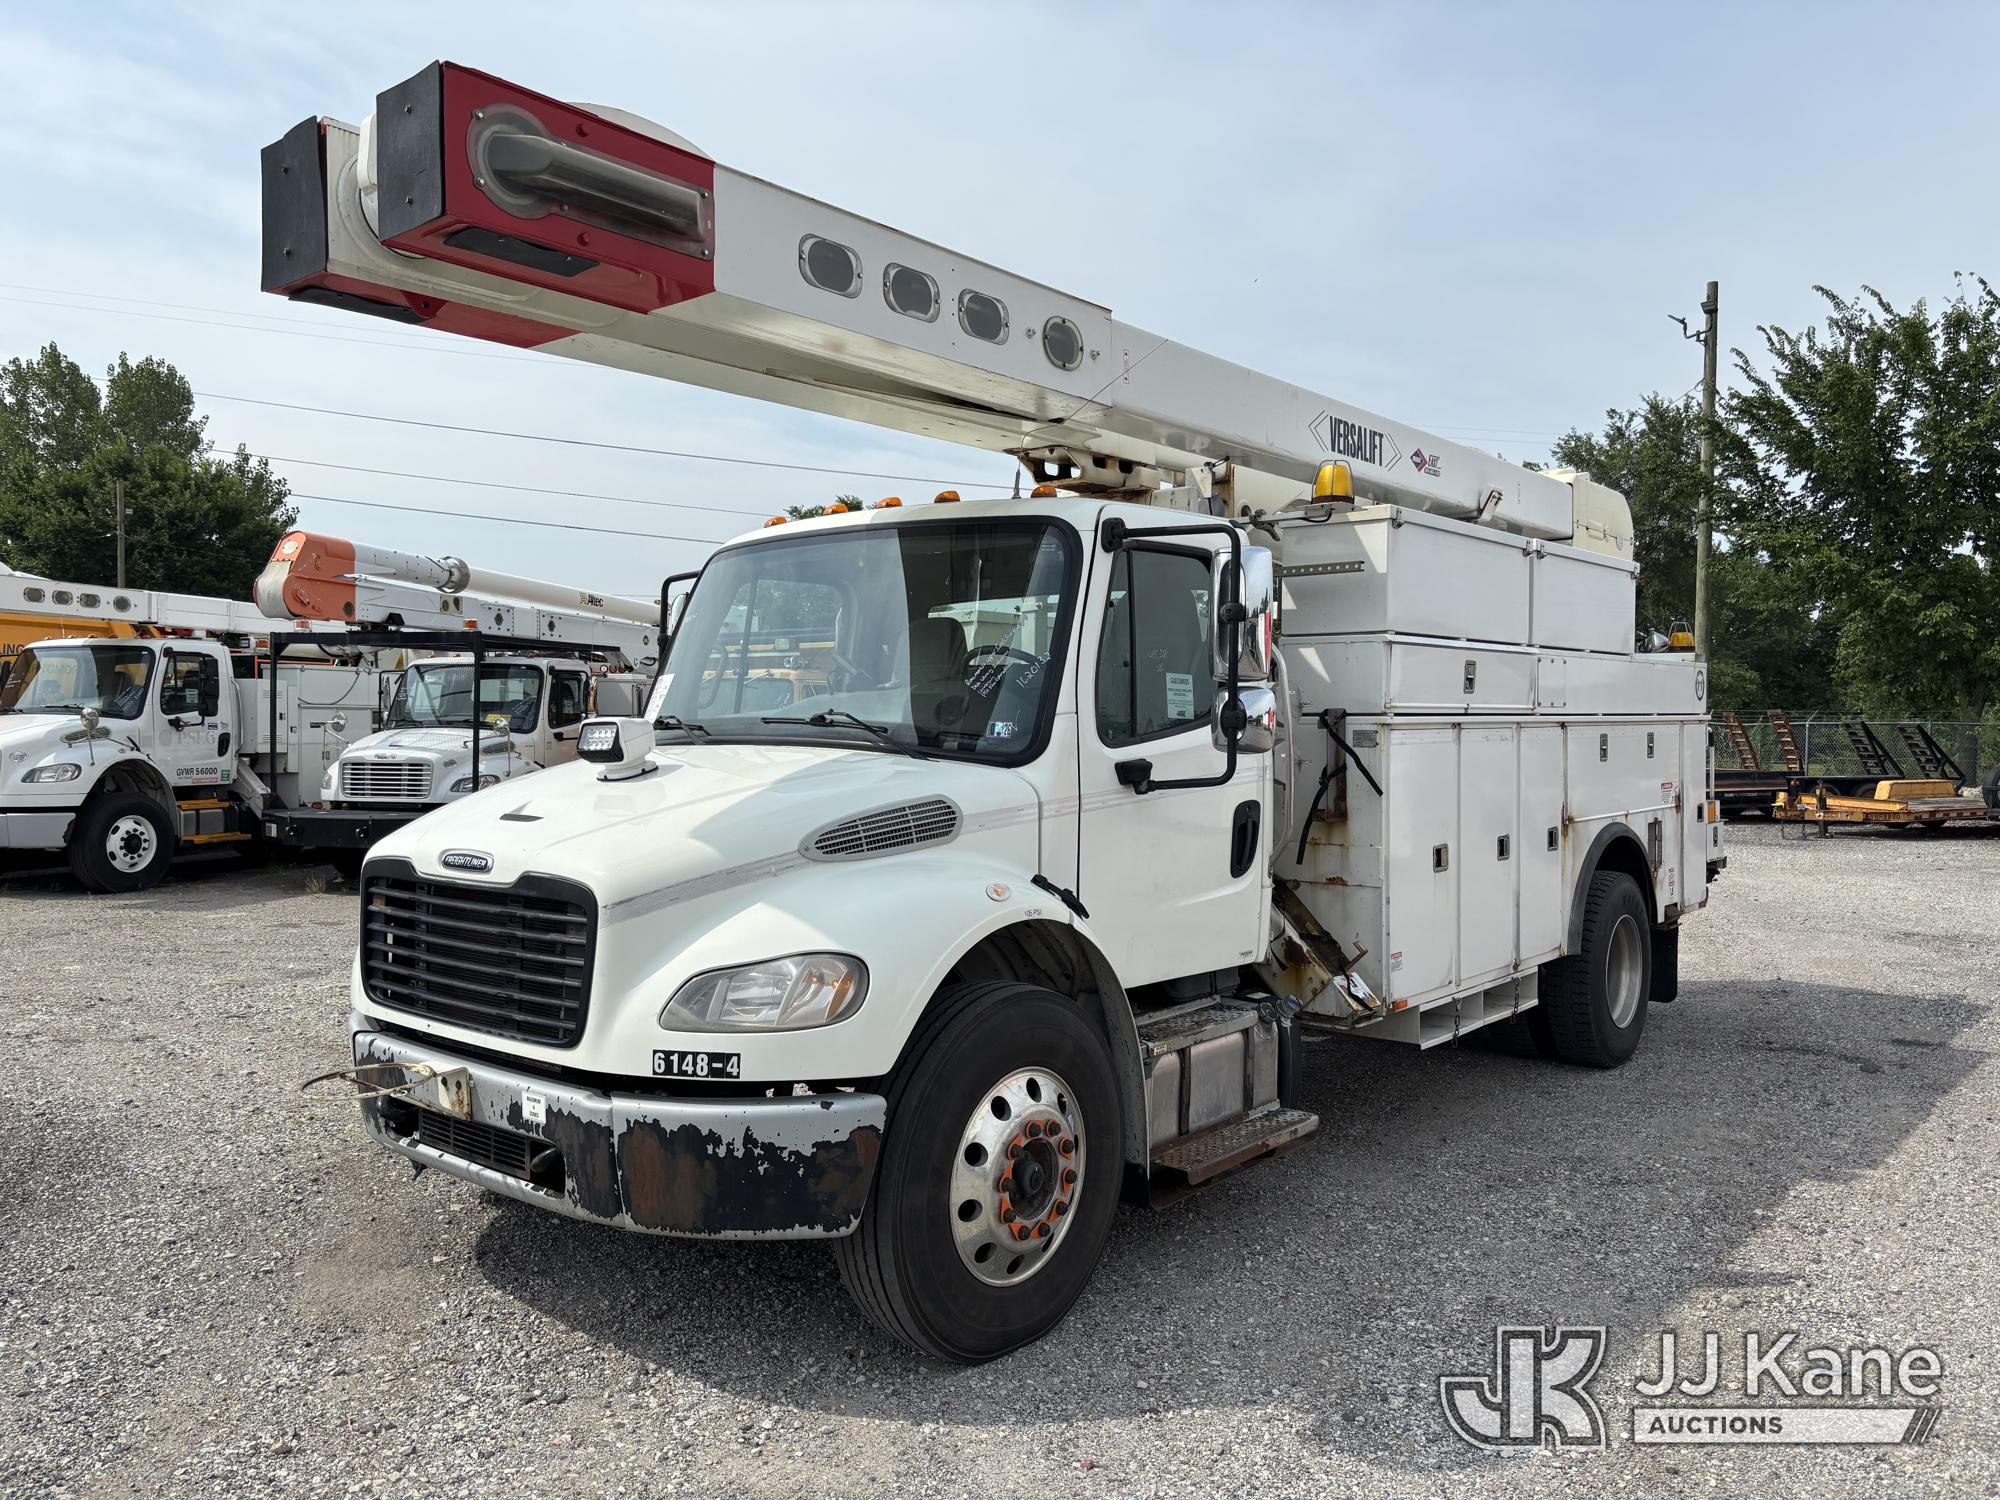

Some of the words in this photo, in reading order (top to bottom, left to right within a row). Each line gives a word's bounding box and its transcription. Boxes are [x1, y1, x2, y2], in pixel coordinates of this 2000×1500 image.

[1329, 415, 1384, 467] VERSALIFT
[176, 767, 195, 777] GVWR
[195, 767, 218, 776] 56000
[444, 855, 487, 868] FREIGHTLINER
[653, 1052, 740, 1077] 6148-4
